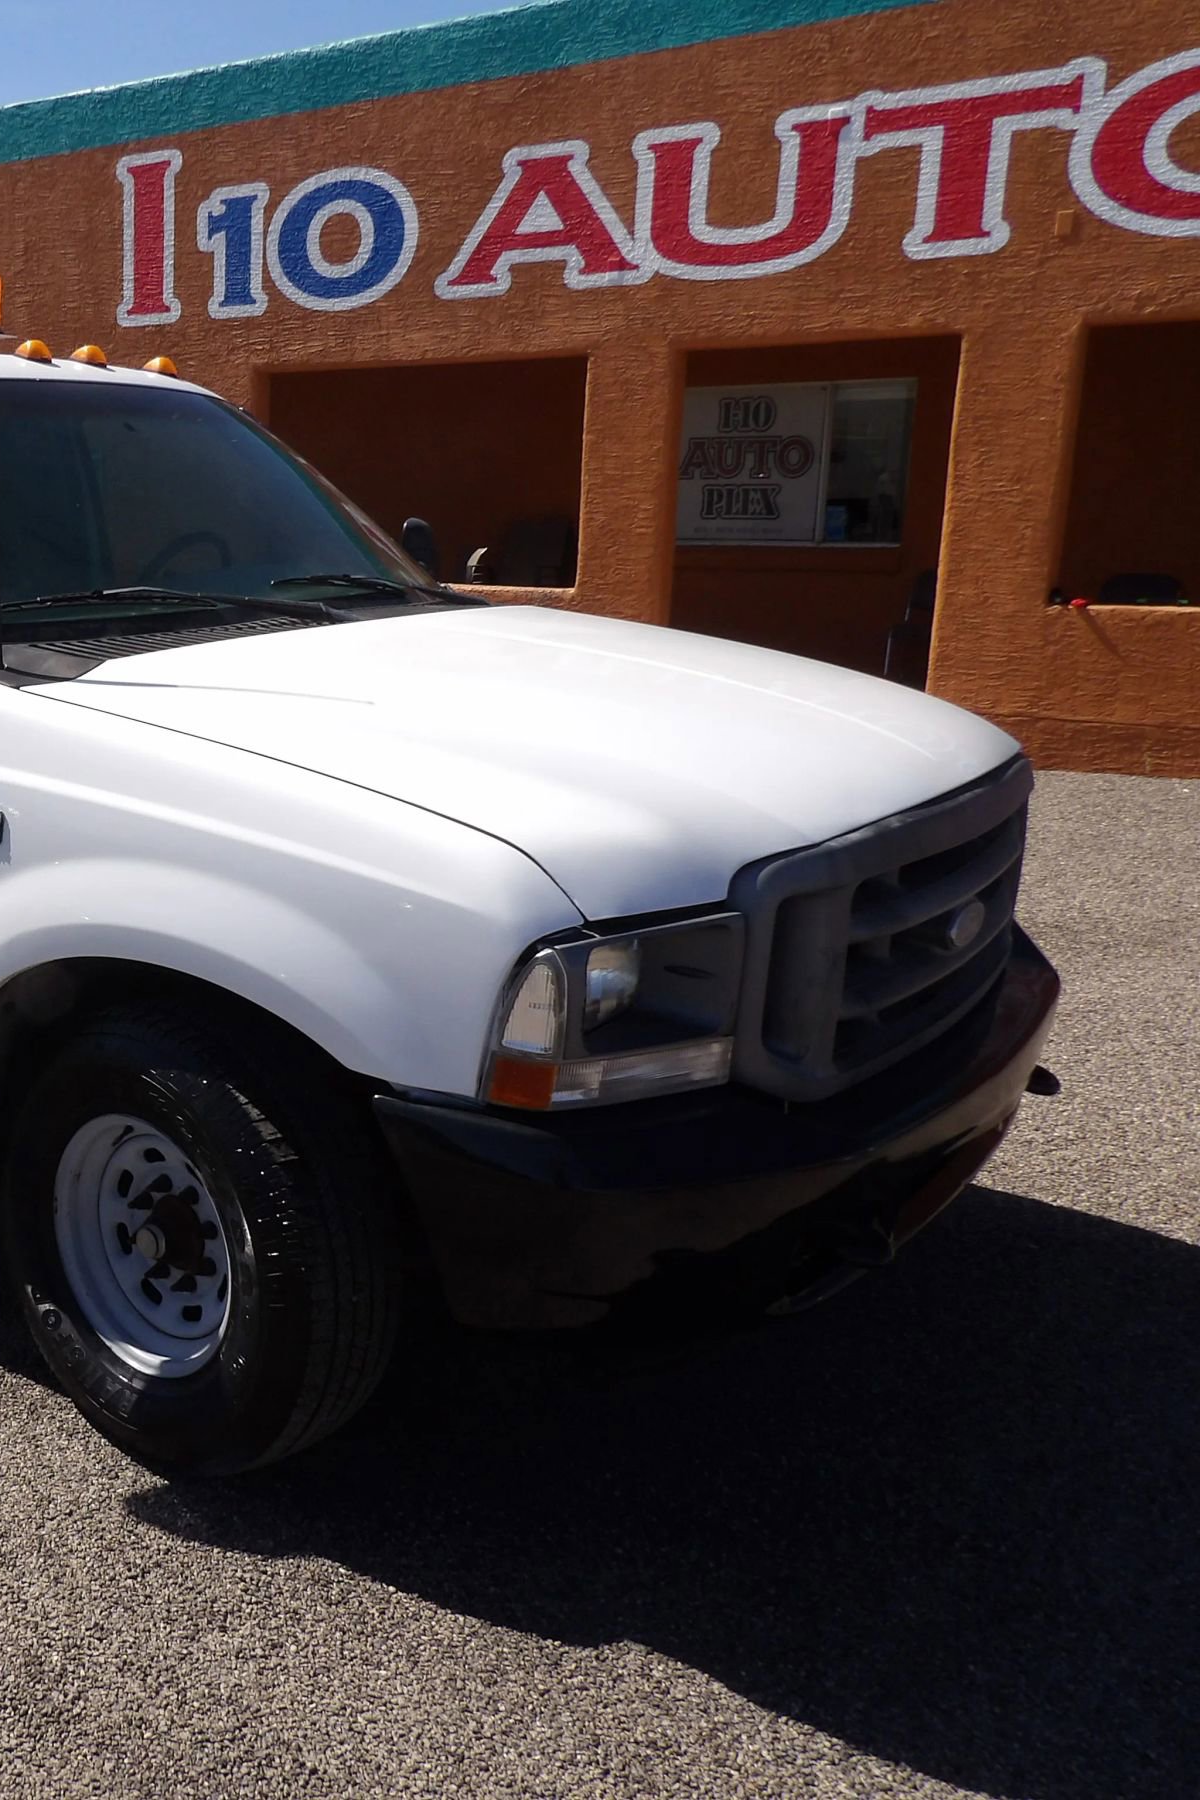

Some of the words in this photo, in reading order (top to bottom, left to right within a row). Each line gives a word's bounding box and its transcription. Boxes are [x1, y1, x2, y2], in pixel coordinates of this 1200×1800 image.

[434, 46, 1200, 299] AUTO
[678, 435, 814, 479] AUTO
[700, 484, 782, 519] PLEX
